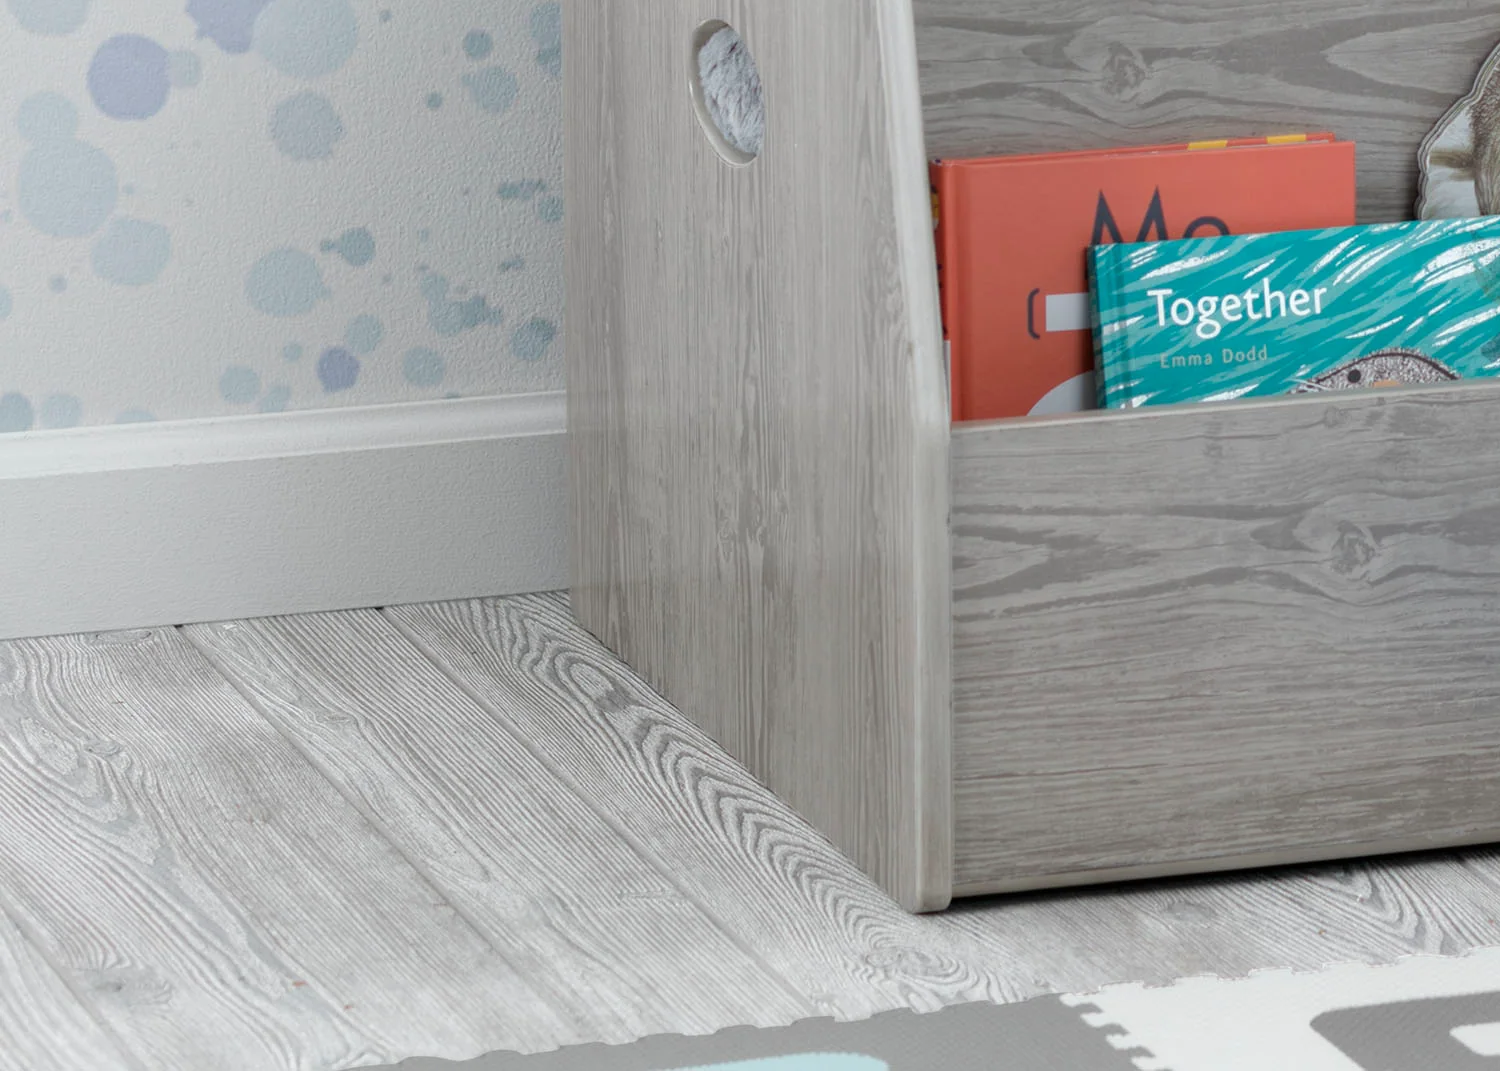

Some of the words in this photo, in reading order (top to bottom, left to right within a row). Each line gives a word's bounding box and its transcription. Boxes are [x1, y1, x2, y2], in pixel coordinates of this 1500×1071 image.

[1147, 277, 1327, 339] Together
[1160, 352, 1213, 369] Emma
[1222, 344, 1268, 364] Dodd
